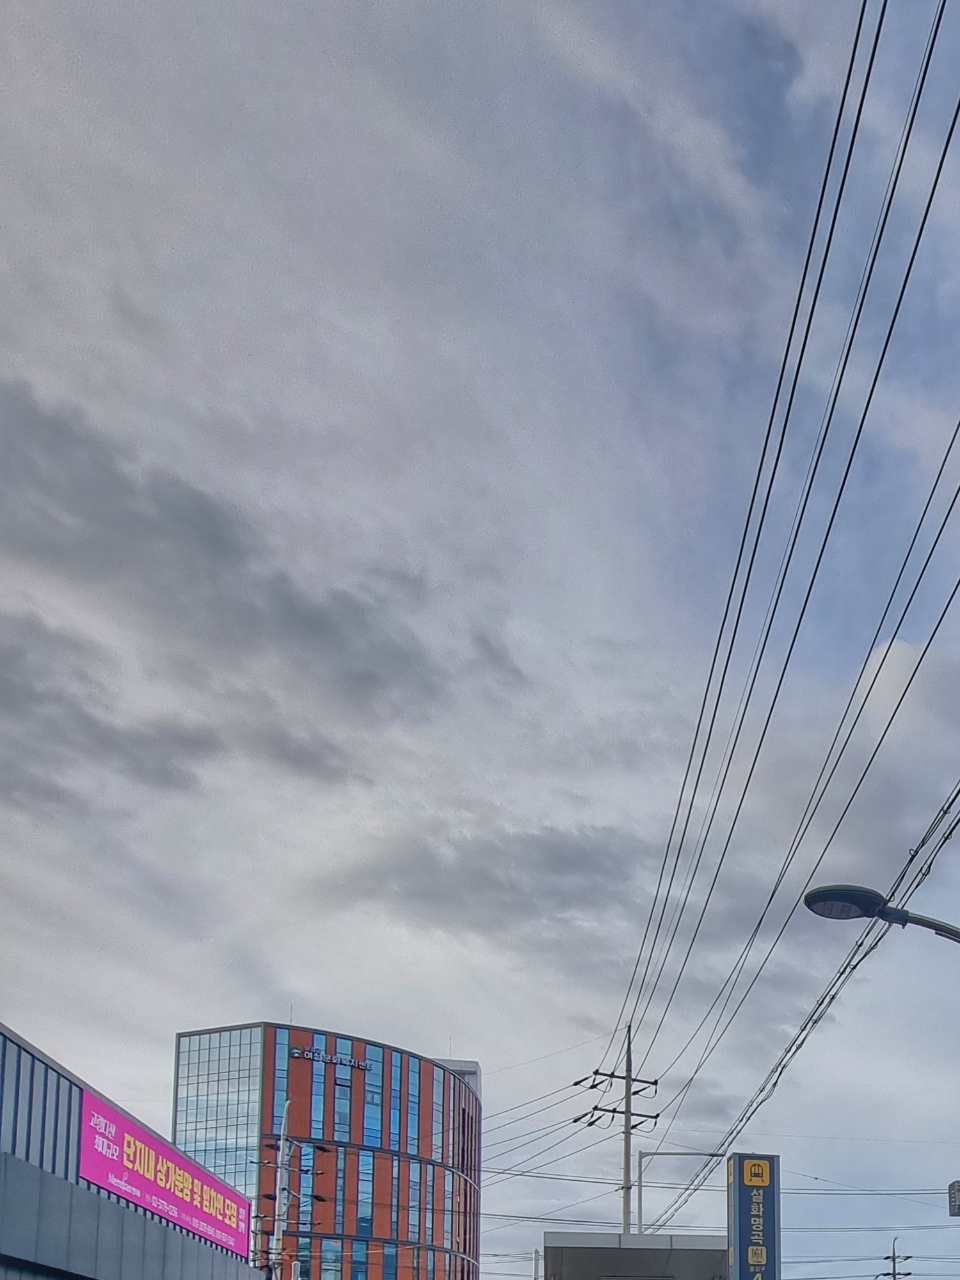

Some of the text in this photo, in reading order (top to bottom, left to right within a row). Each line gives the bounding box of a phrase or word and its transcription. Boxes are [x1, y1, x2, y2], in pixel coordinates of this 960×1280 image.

[122, 1132, 155, 1181] 단지내
[193, 1179, 202, 1208] 및
[224, 1199, 238, 1229] 모집
[750, 1189, 765, 1245] 설화명곡
